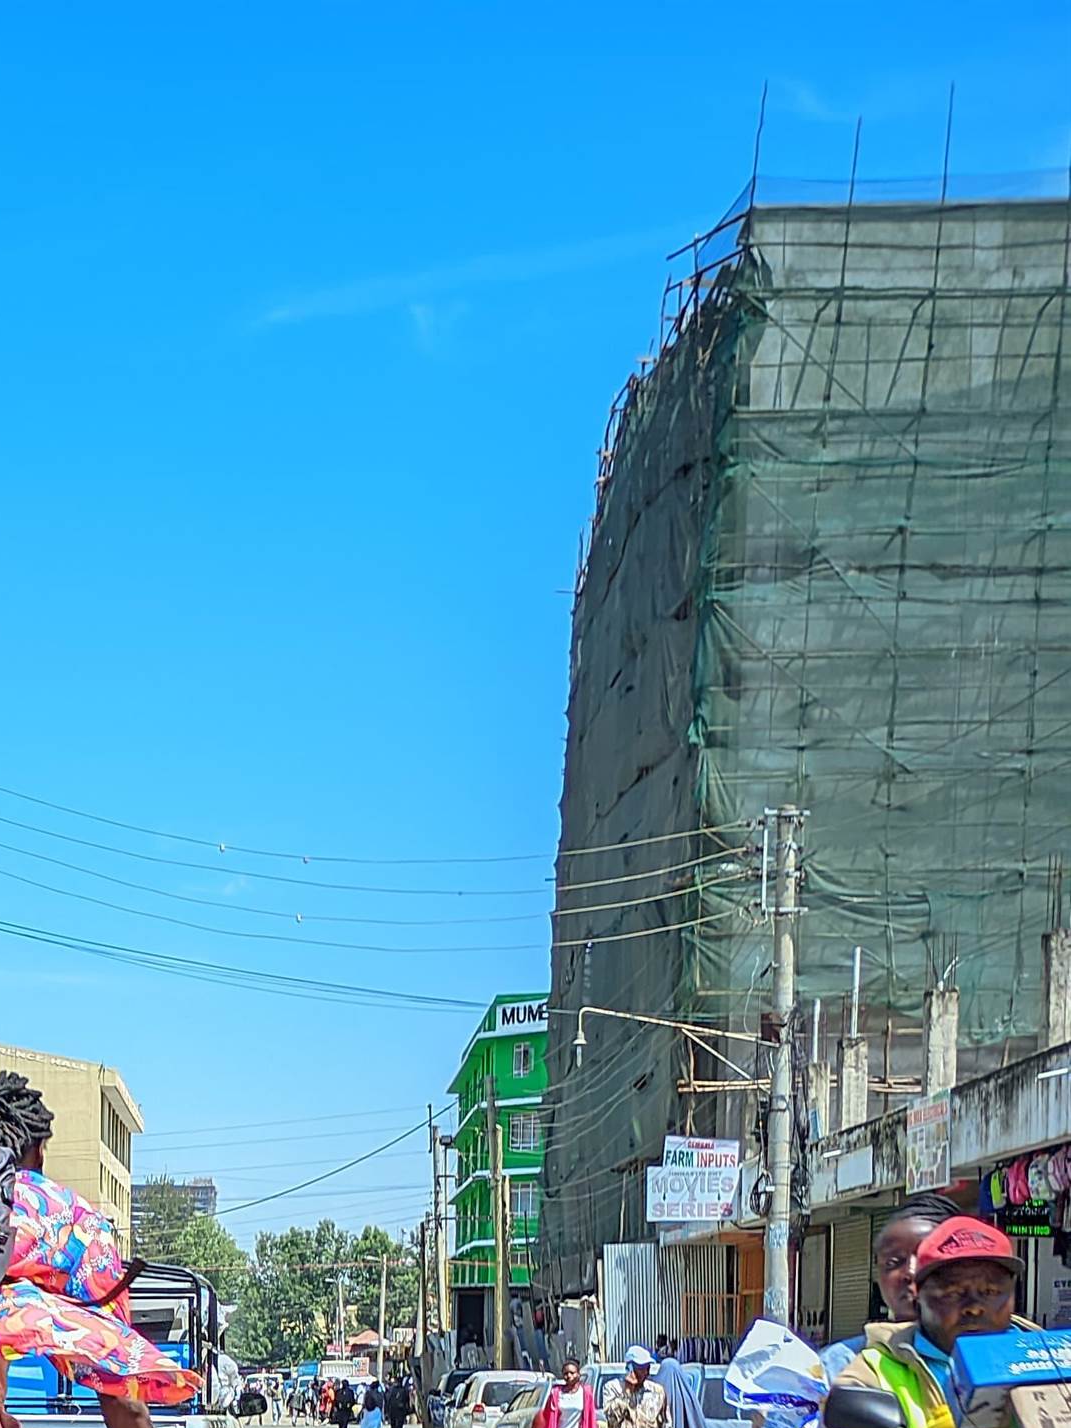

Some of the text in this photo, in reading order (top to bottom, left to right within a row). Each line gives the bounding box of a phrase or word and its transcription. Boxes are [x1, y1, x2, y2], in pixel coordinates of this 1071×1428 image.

[50, 1056, 88, 1072] HALL
[664, 1149, 736, 1168] FARM INPUTS
[652, 1202, 733, 1218] SERIES
